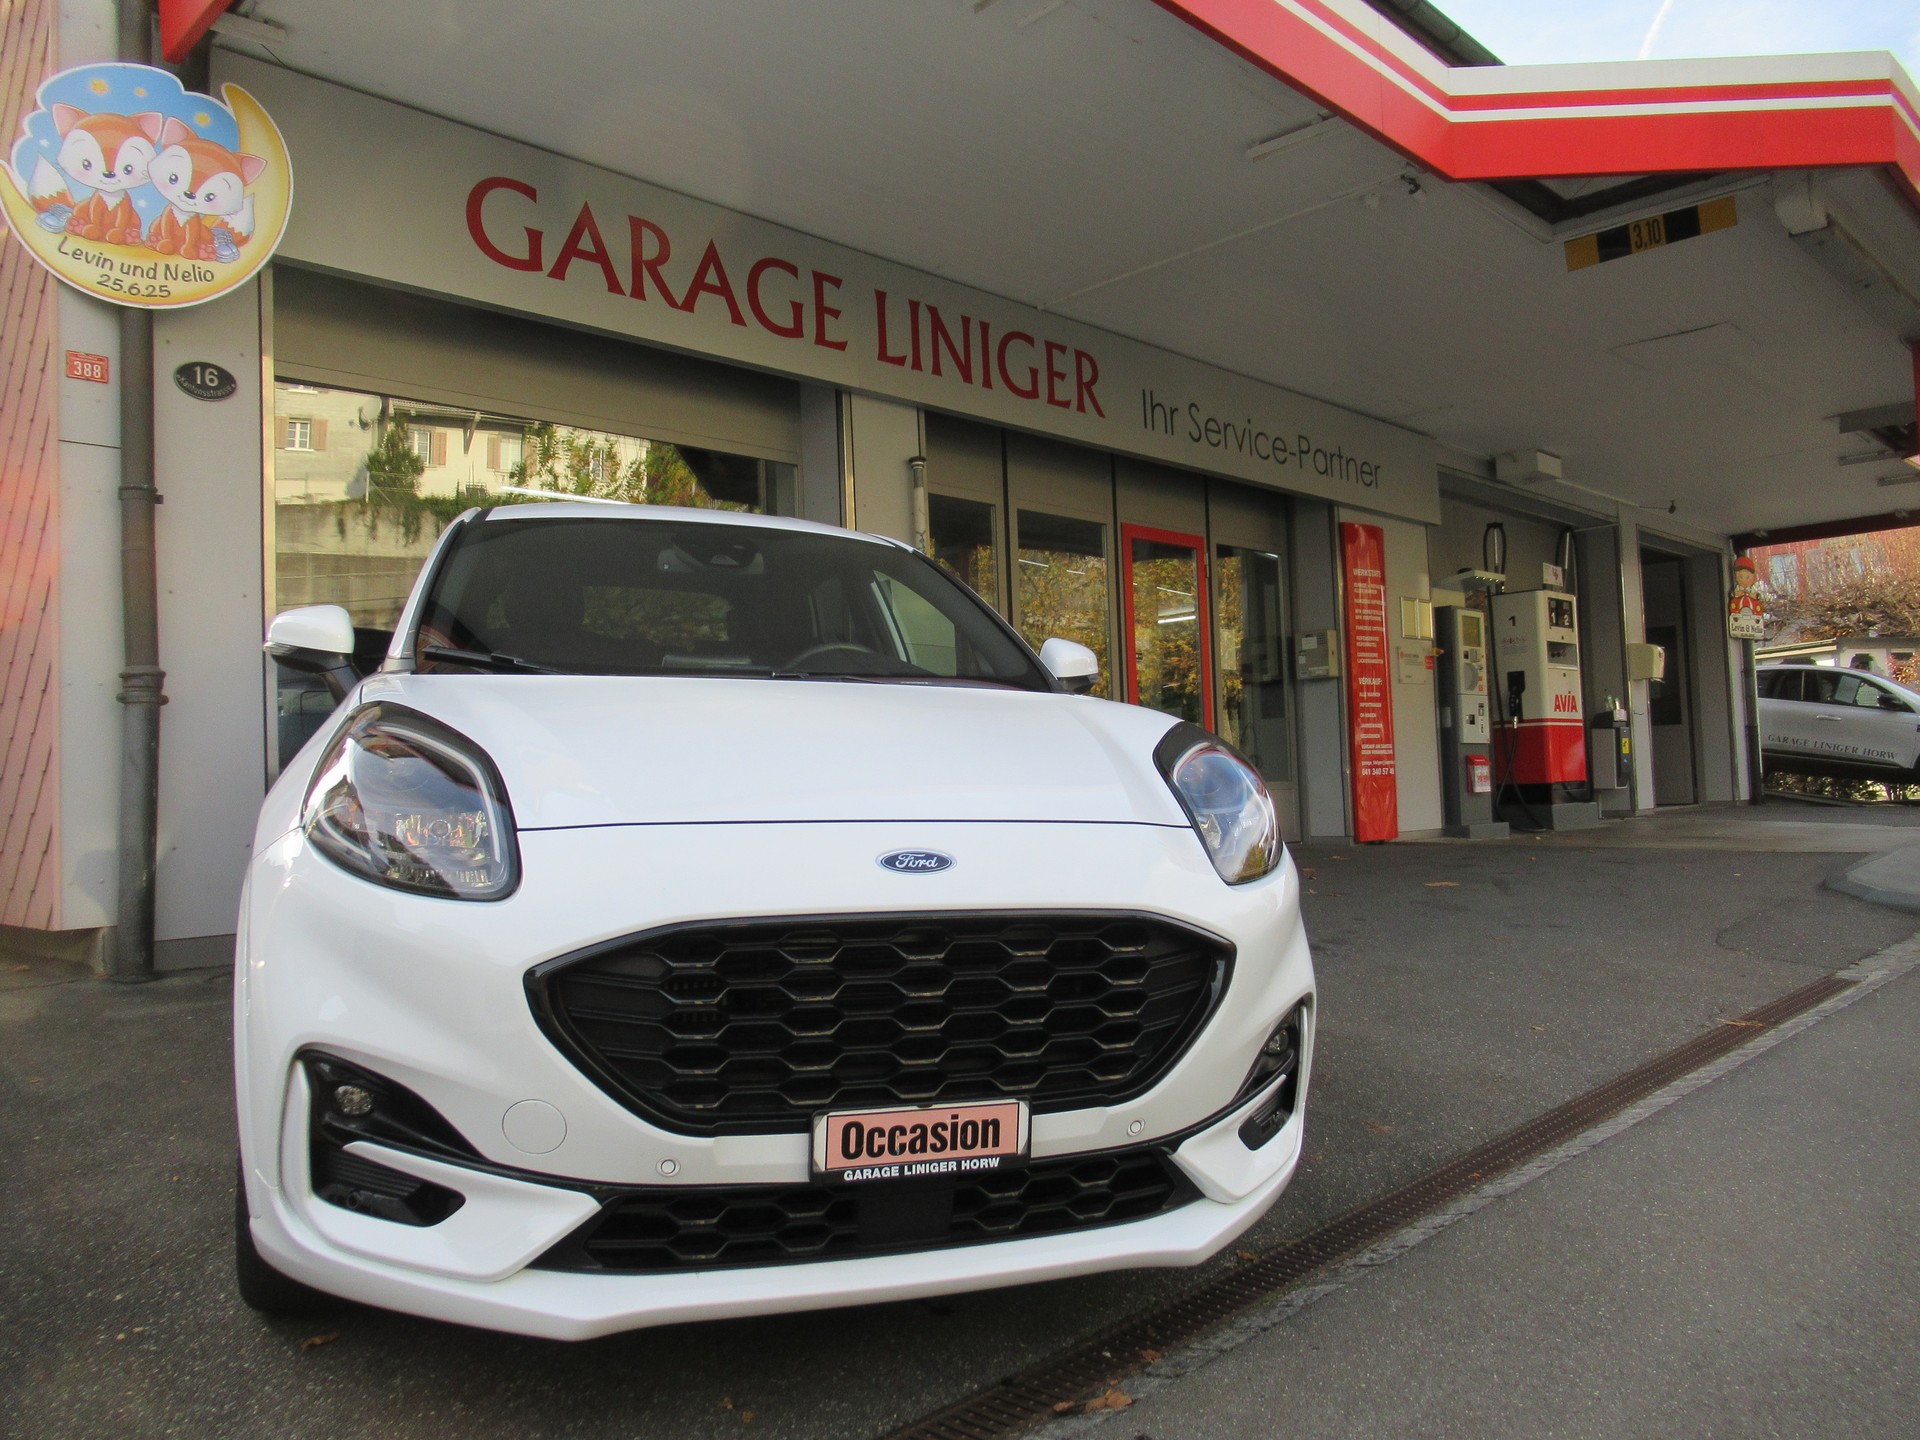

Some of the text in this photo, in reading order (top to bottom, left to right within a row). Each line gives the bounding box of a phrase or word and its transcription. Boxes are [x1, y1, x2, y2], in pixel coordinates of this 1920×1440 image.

[1632, 218, 1662, 250] 3.10
[58, 236, 215, 283] Levin und Nelio
[96, 273, 171, 298] 25.6.25
[466, 176, 1106, 418] GARAGE LINIGER
[73, 361, 101, 379] 388
[194, 365, 219, 387] 16
[1142, 388, 1381, 490] Ihr Service-Partner
[1508, 615, 1517, 627] 1
[1767, 734, 1897, 760] GARAGE LINIGER HORW
[895, 853, 939, 869] Ford
[840, 1114, 1001, 1160] Occasion
[843, 1157, 1000, 1182] GARAGE LINIGER HORW
